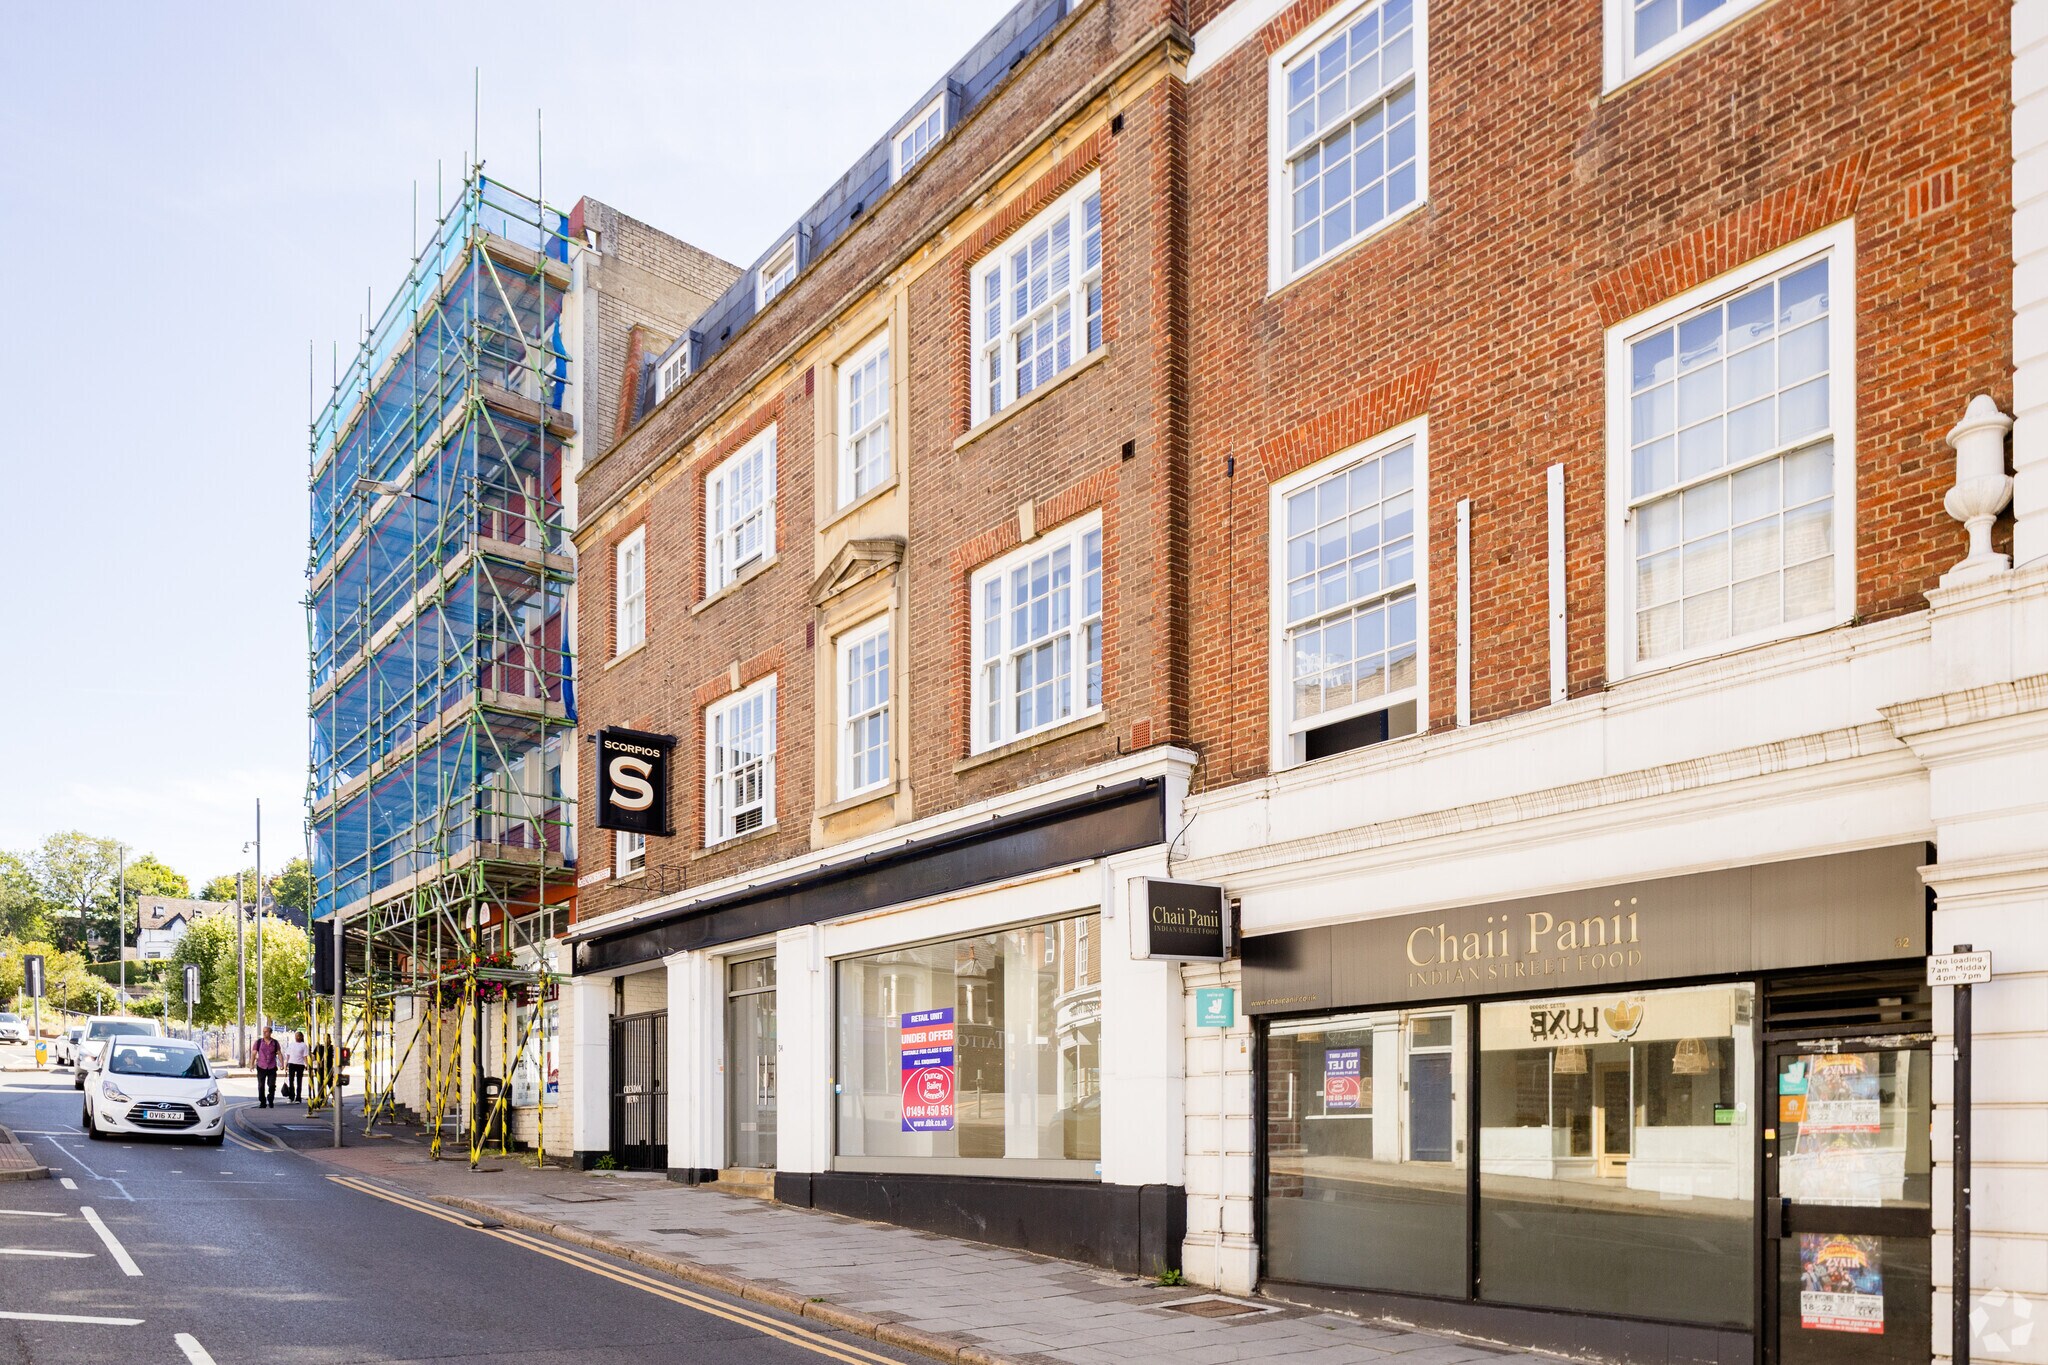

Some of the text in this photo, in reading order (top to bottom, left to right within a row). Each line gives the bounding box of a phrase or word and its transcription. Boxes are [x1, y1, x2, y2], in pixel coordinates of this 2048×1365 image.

[604, 740, 660, 757] SCORPIOS
[609, 756, 653, 811] S
[1152, 905, 1219, 928] Chaii Panii
[1406, 897, 1641, 967] Chaii Panii
[1895, 937, 1909, 949] 32
[1950, 956, 1983, 965] loading
[1408, 949, 1642, 988] INDIAN STREET FOOD
[1955, 964, 1987, 972] Midday
[1935, 974, 1956, 982] 4pm
[911, 1012, 943, 1023] RETAIL UNIT
[901, 1029, 953, 1044] UNDER OFFER
[924, 1073, 944, 1081] Duncan
[926, 1081, 942, 1090] Bailey
[923, 1089, 945, 1100] Kennedy
[906, 1104, 953, 1117] 01494 450 951
[913, 1118, 948, 1128] www.dbk.co.uk
[1826, 1257, 1860, 1268] ZYAIR
[1804, 1303, 1815, 1311] 18
